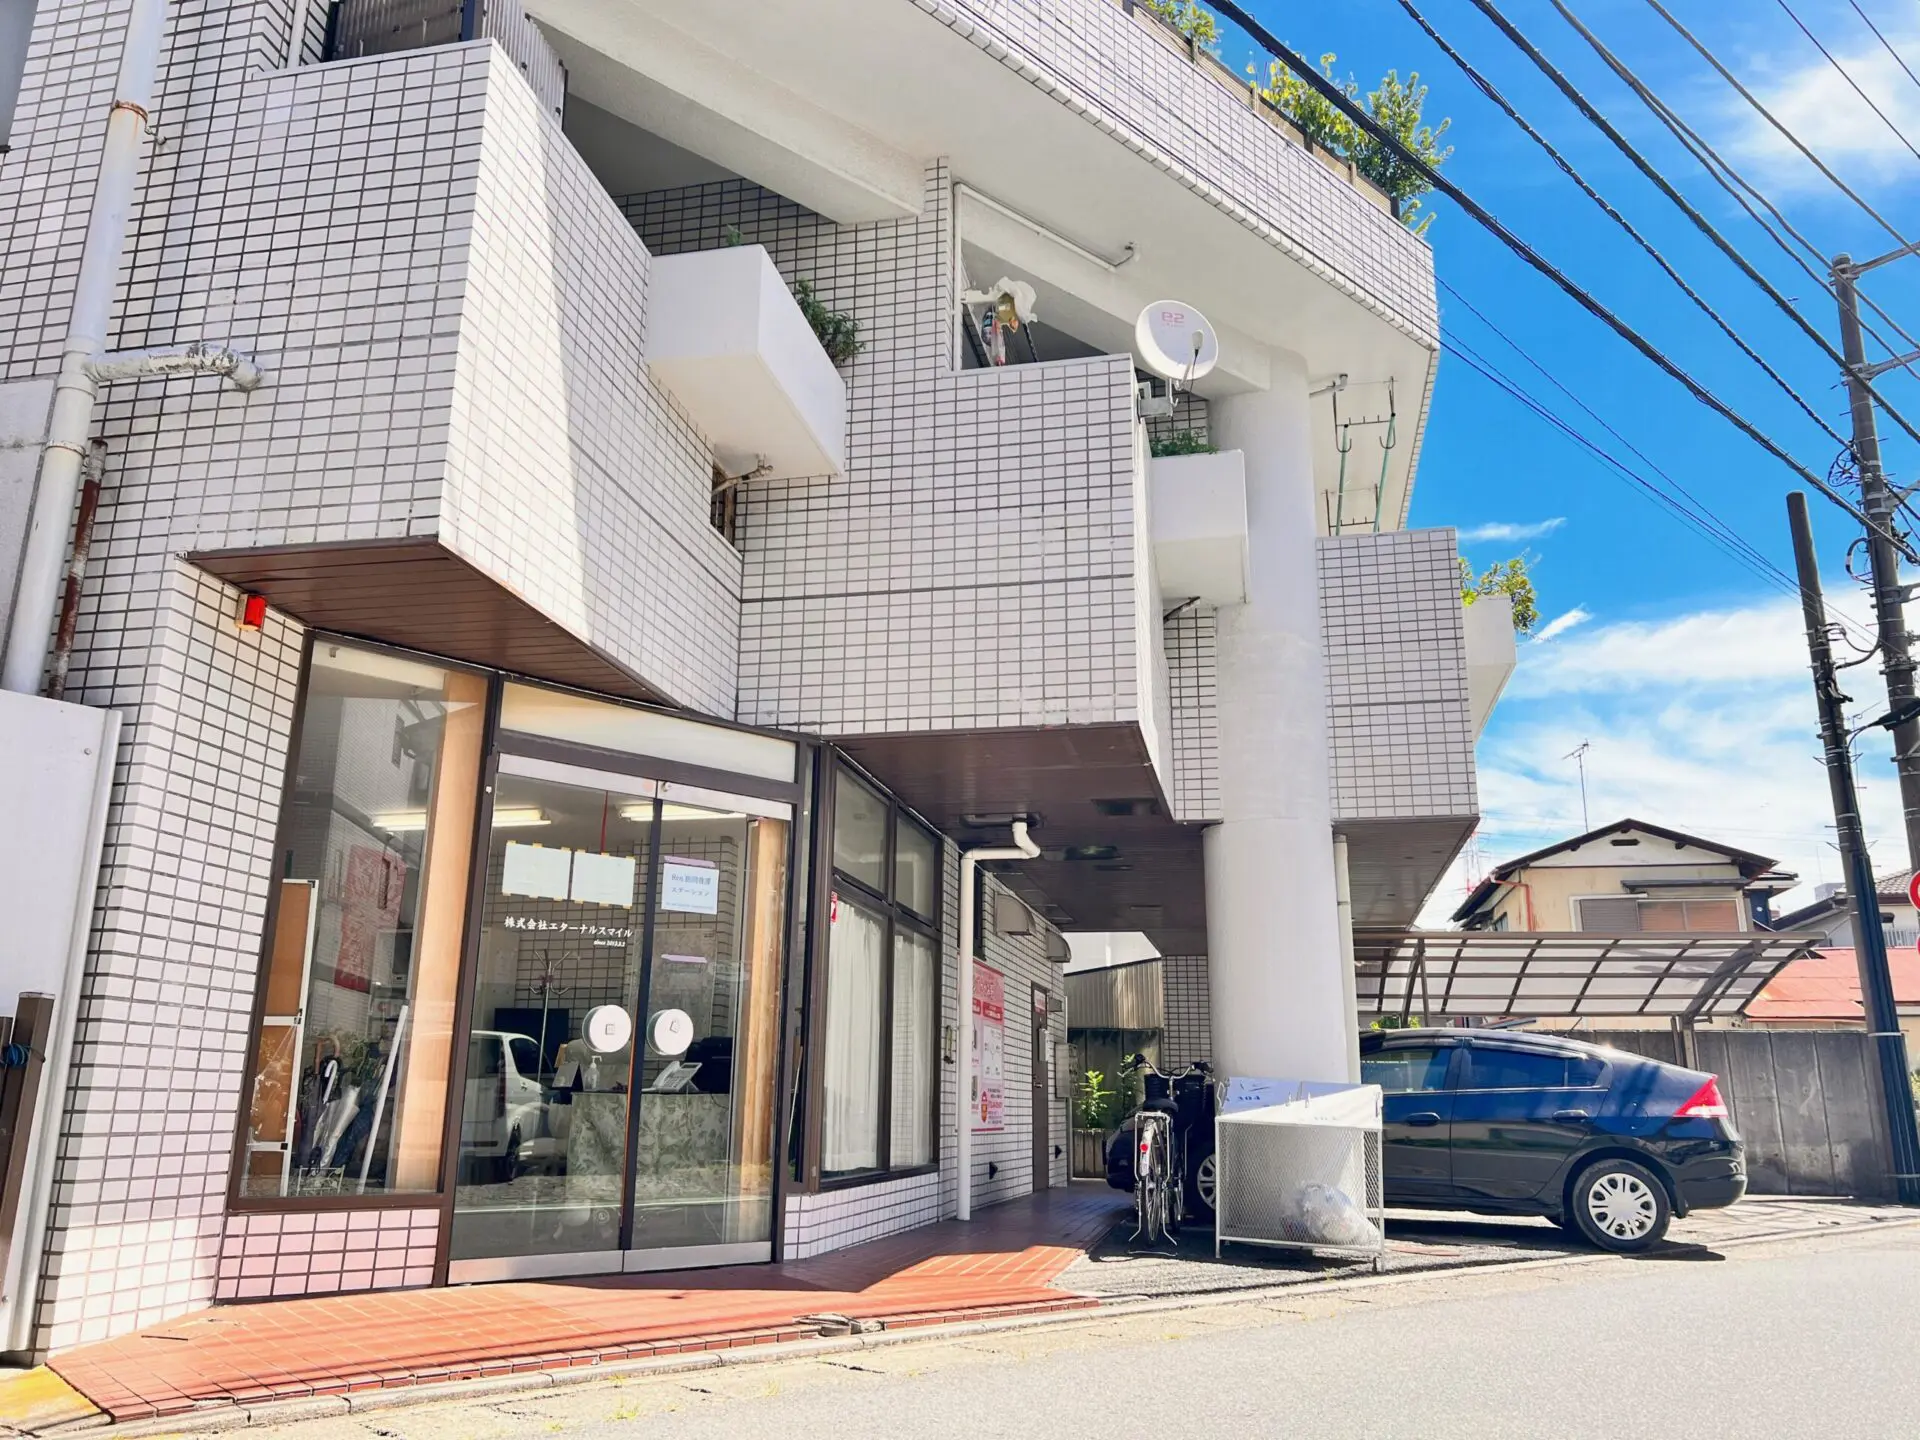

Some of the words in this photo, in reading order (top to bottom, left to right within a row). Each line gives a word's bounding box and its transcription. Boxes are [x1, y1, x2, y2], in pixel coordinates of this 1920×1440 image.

[504, 916, 633, 938] 株式会社エターナルスマイル
